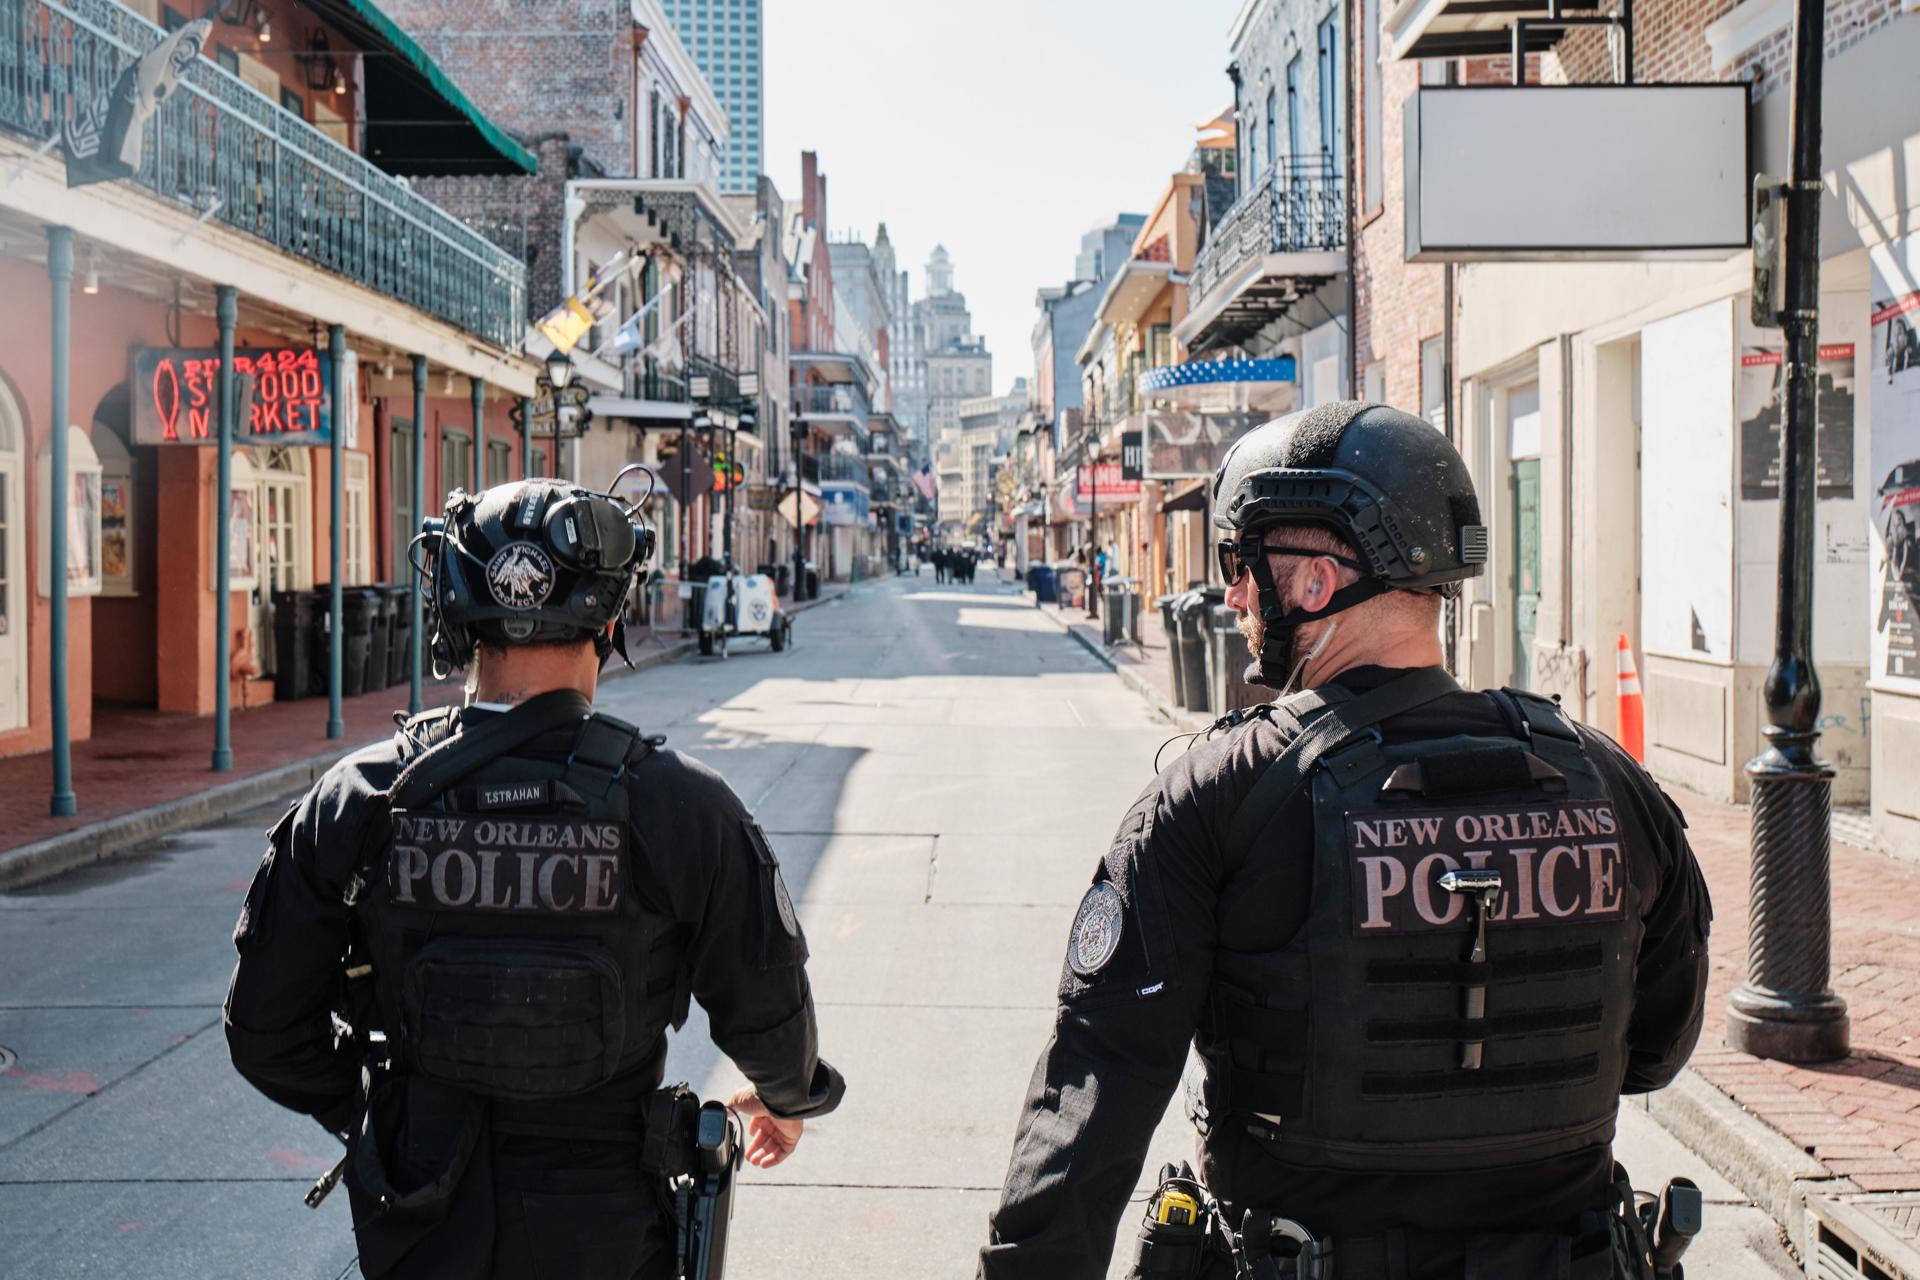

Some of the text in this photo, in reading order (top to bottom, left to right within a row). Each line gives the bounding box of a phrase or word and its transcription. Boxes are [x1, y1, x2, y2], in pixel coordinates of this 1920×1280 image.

[183, 356, 256, 379] PIR
[187, 369, 323, 407] SOOD
[490, 545, 550, 579] SAINT MICHAEL
[494, 582, 550, 607] PROTECT US
[395, 817, 622, 850] NEW ORLEANS
[1353, 807, 1617, 849] NEW ORLEANS
[395, 845, 619, 912] POLICE
